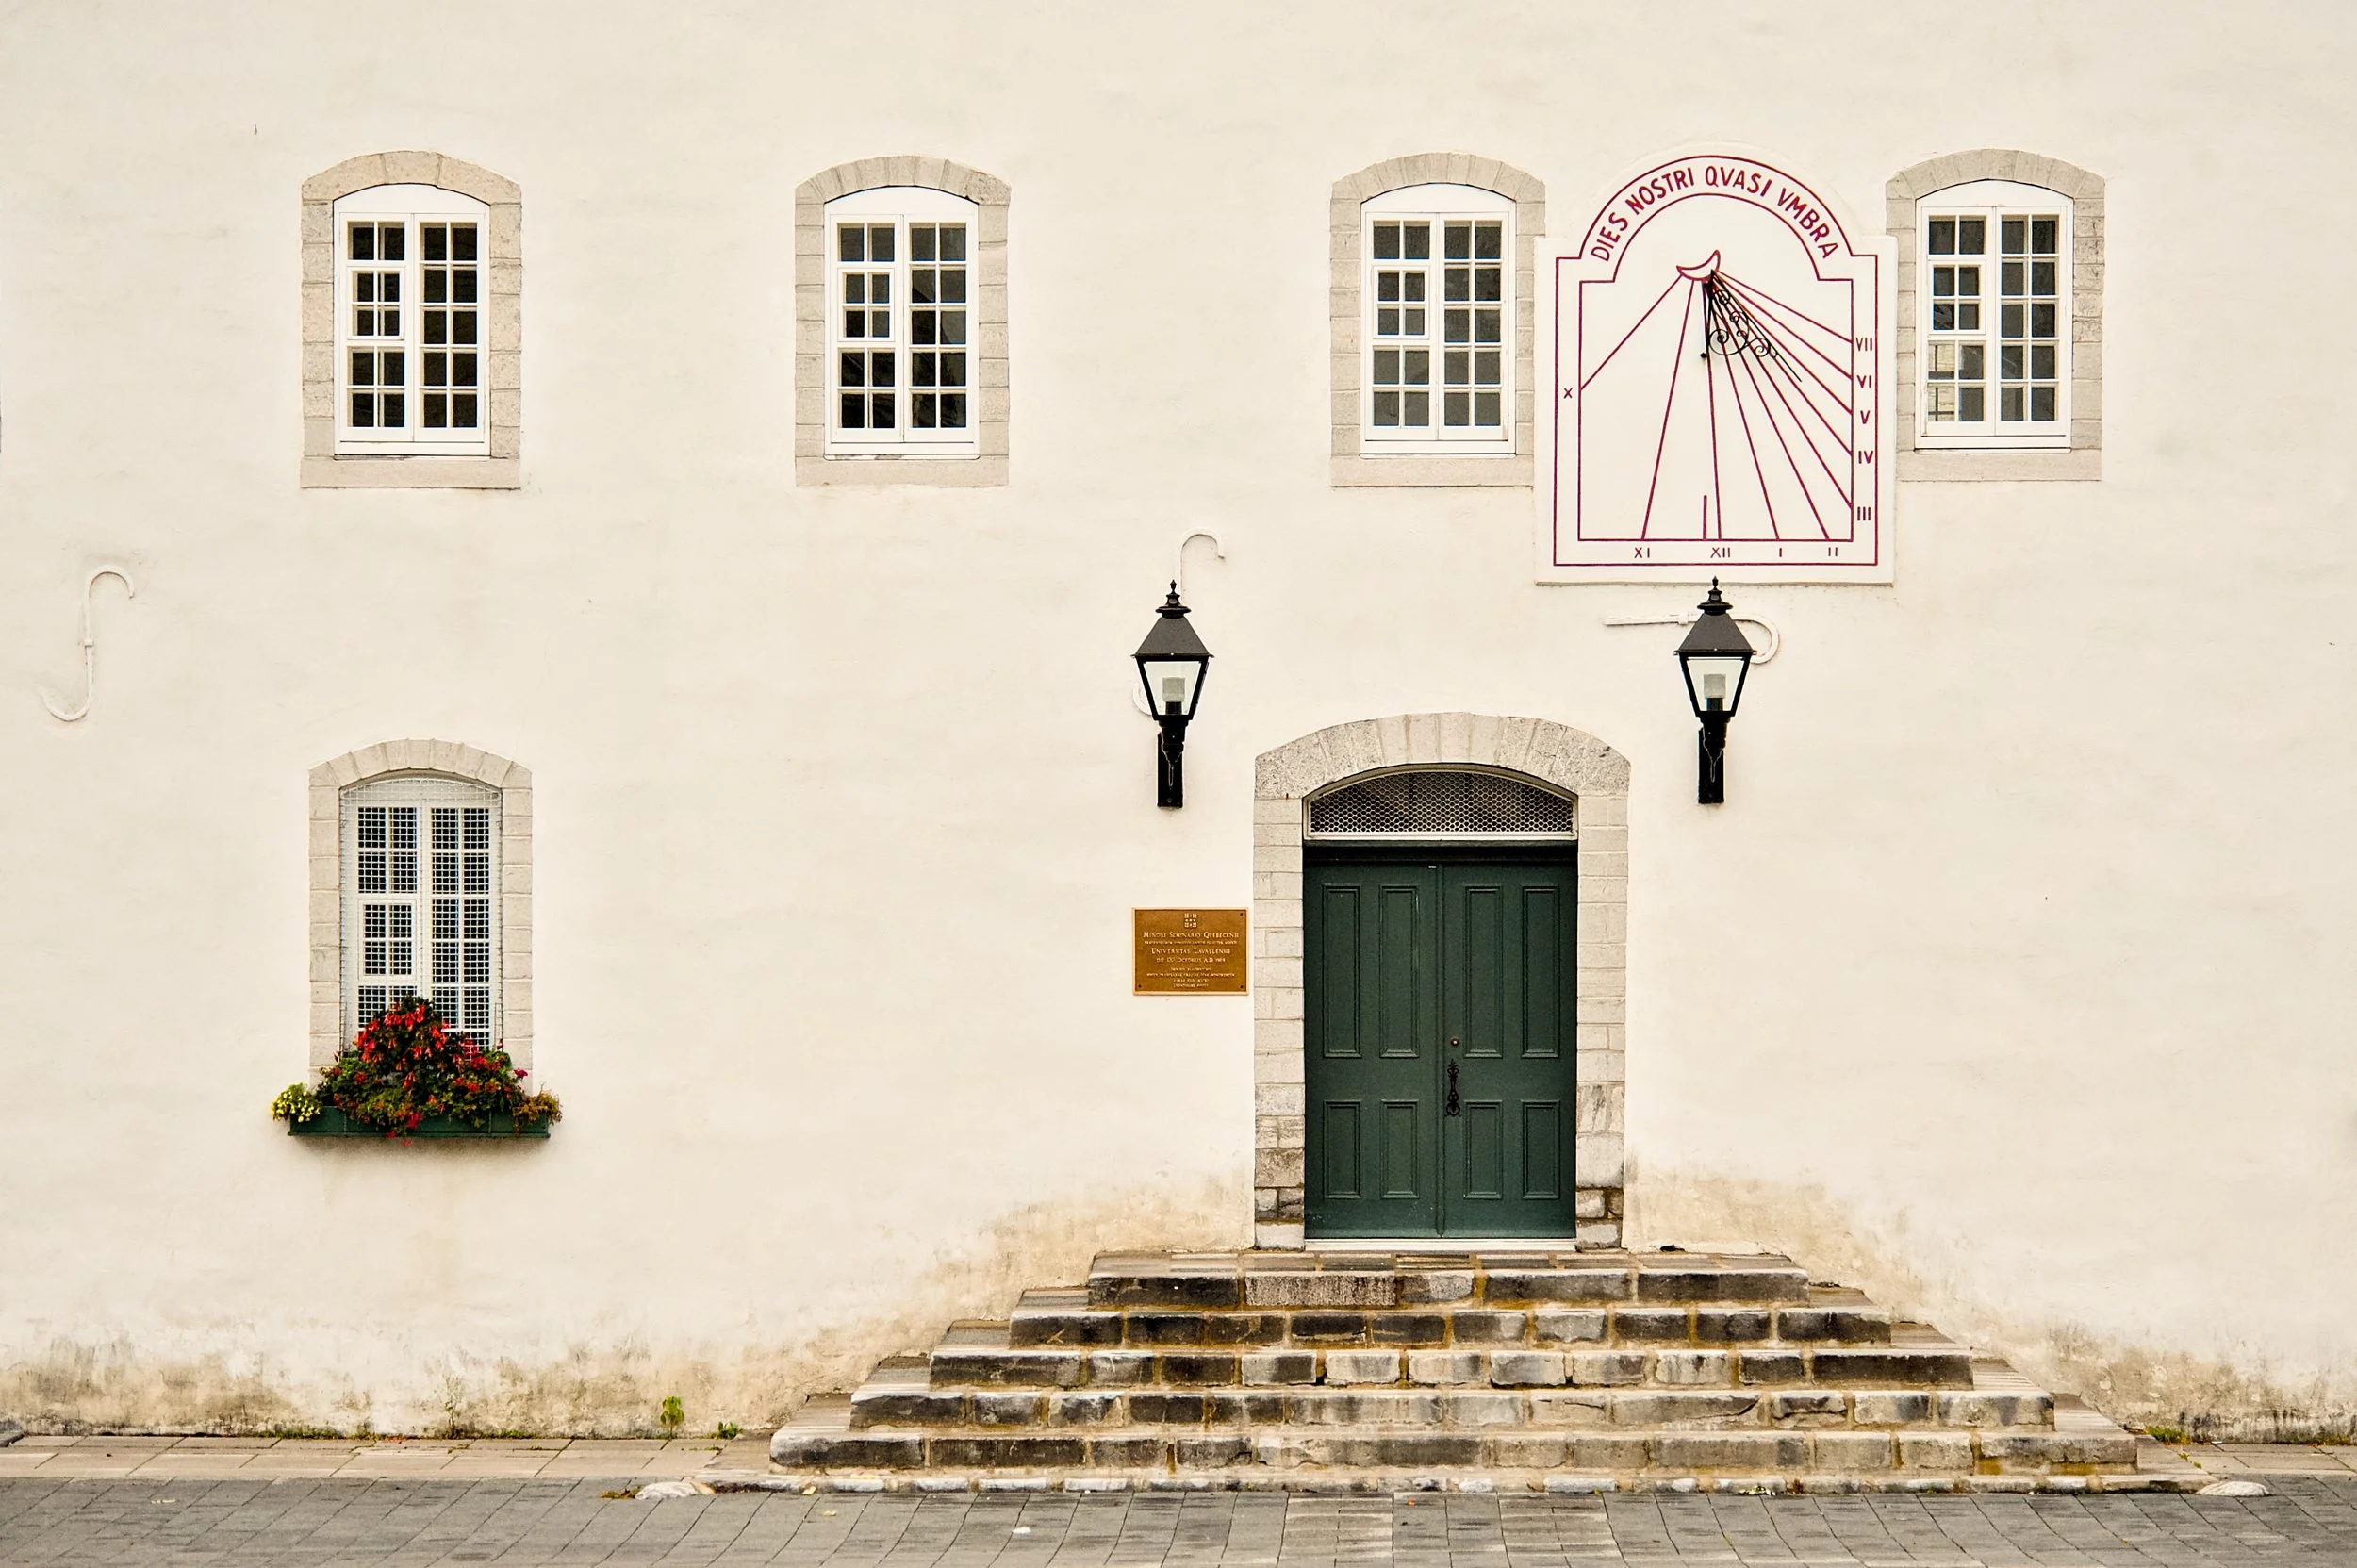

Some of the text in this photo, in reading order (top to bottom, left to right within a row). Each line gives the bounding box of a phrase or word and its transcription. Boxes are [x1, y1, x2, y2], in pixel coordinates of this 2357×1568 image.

[1590, 166, 1839, 262] DIES NOSTRI QVASI VMBRA
[1855, 338, 1873, 351] VII
[1856, 375, 1872, 388] VI
[1563, 388, 1574, 400] X
[1859, 410, 1871, 425] V
[1857, 450, 1874, 464] IV
[1856, 506, 1871, 521] III
[1634, 547, 1650, 559] XI
[1710, 547, 1731, 559] XII
[1827, 547, 1838, 558] II
